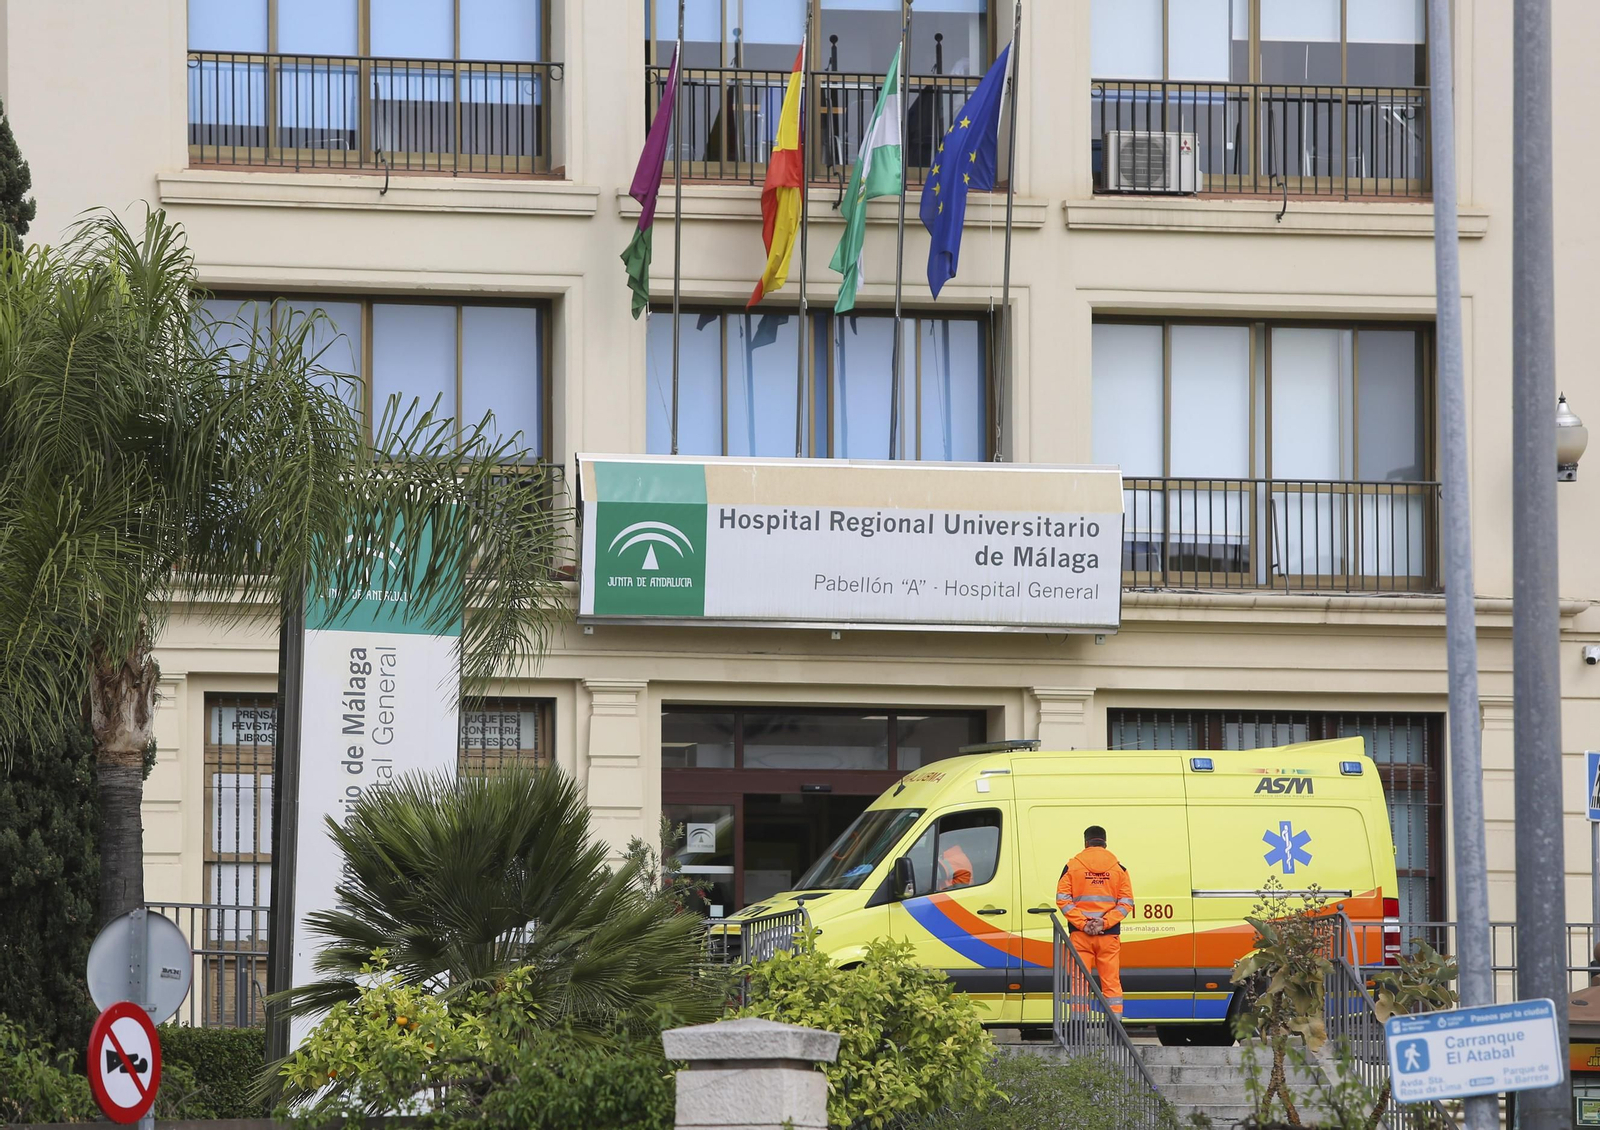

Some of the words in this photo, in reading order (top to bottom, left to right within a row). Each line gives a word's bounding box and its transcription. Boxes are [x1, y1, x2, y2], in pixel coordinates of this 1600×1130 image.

[719, 508, 820, 535] Hospital
[830, 510, 934, 537] Regional
[944, 513, 1100, 538] Universitario
[975, 545, 1004, 566] de
[1013, 546, 1099, 574] Málaga
[607, 576, 633, 587] JUNTA
[636, 576, 647, 587] DE
[814, 574, 893, 594] Pabellón
[945, 579, 1020, 600] Hospital
[1028, 581, 1099, 600] General
[342, 647, 372, 735] Málaga
[371, 647, 396, 745] General
[466, 714, 517, 724] UGUEES
[341, 745, 364, 775] de
[1254, 777, 1314, 795] ASM
[1143, 904, 1173, 919] 880
[1470, 1014, 1499, 1023] Paseos
[1523, 1007, 1549, 1017] ciudad
[1445, 1031, 1525, 1050] Carranque
[1446, 1051, 1461, 1065] El
[1466, 1046, 1515, 1063] Atabal
